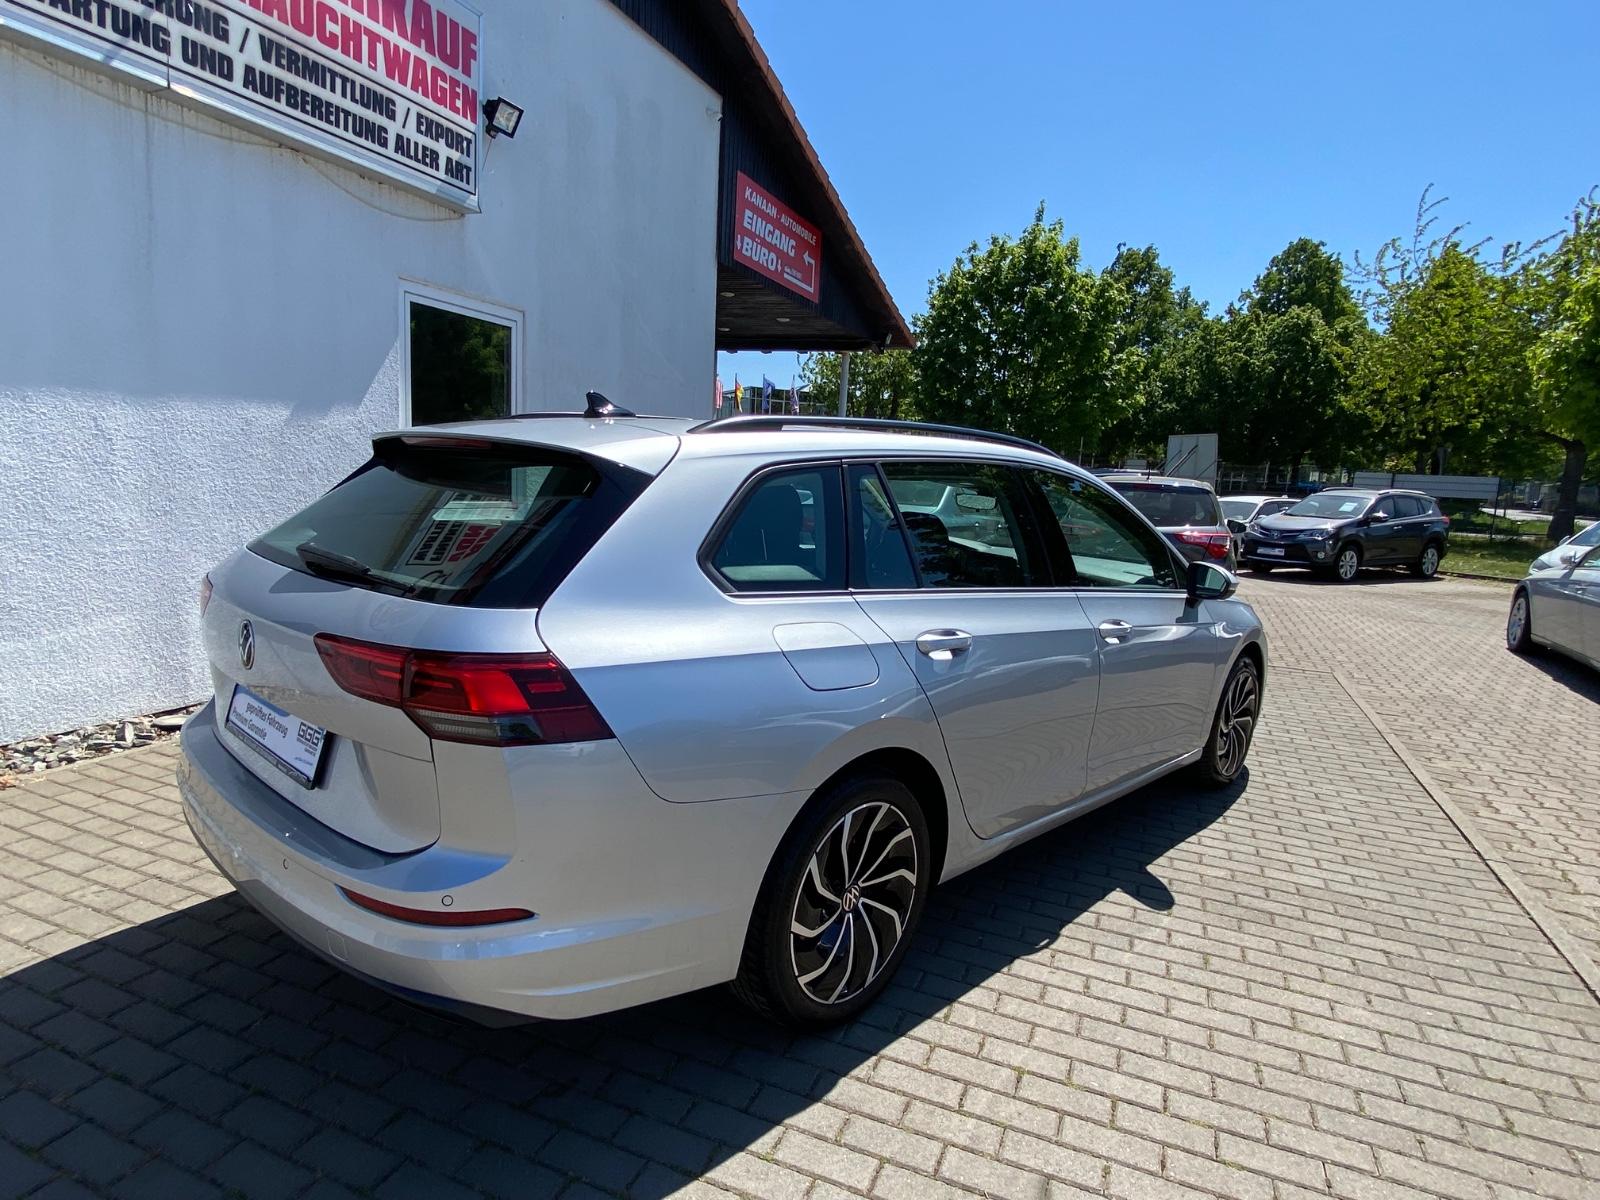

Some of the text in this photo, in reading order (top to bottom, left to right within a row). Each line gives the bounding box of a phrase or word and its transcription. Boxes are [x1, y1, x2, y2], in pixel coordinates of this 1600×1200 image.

[338, 0, 477, 78] KAUF
[181, 35, 234, 82] UND
[243, 64, 389, 150] AUFBEREITUNG
[394, 133, 440, 172] ALLER
[445, 156, 472, 185] ART
[258, 33, 397, 122] VERMITTLUNG
[416, 112, 472, 158] EXPORT
[743, 209, 795, 257] EINGANG
[745, 187, 776, 218] KANAAN
[781, 214, 816, 246] AUTOMOBILE
[742, 238, 776, 271] BÜRO
